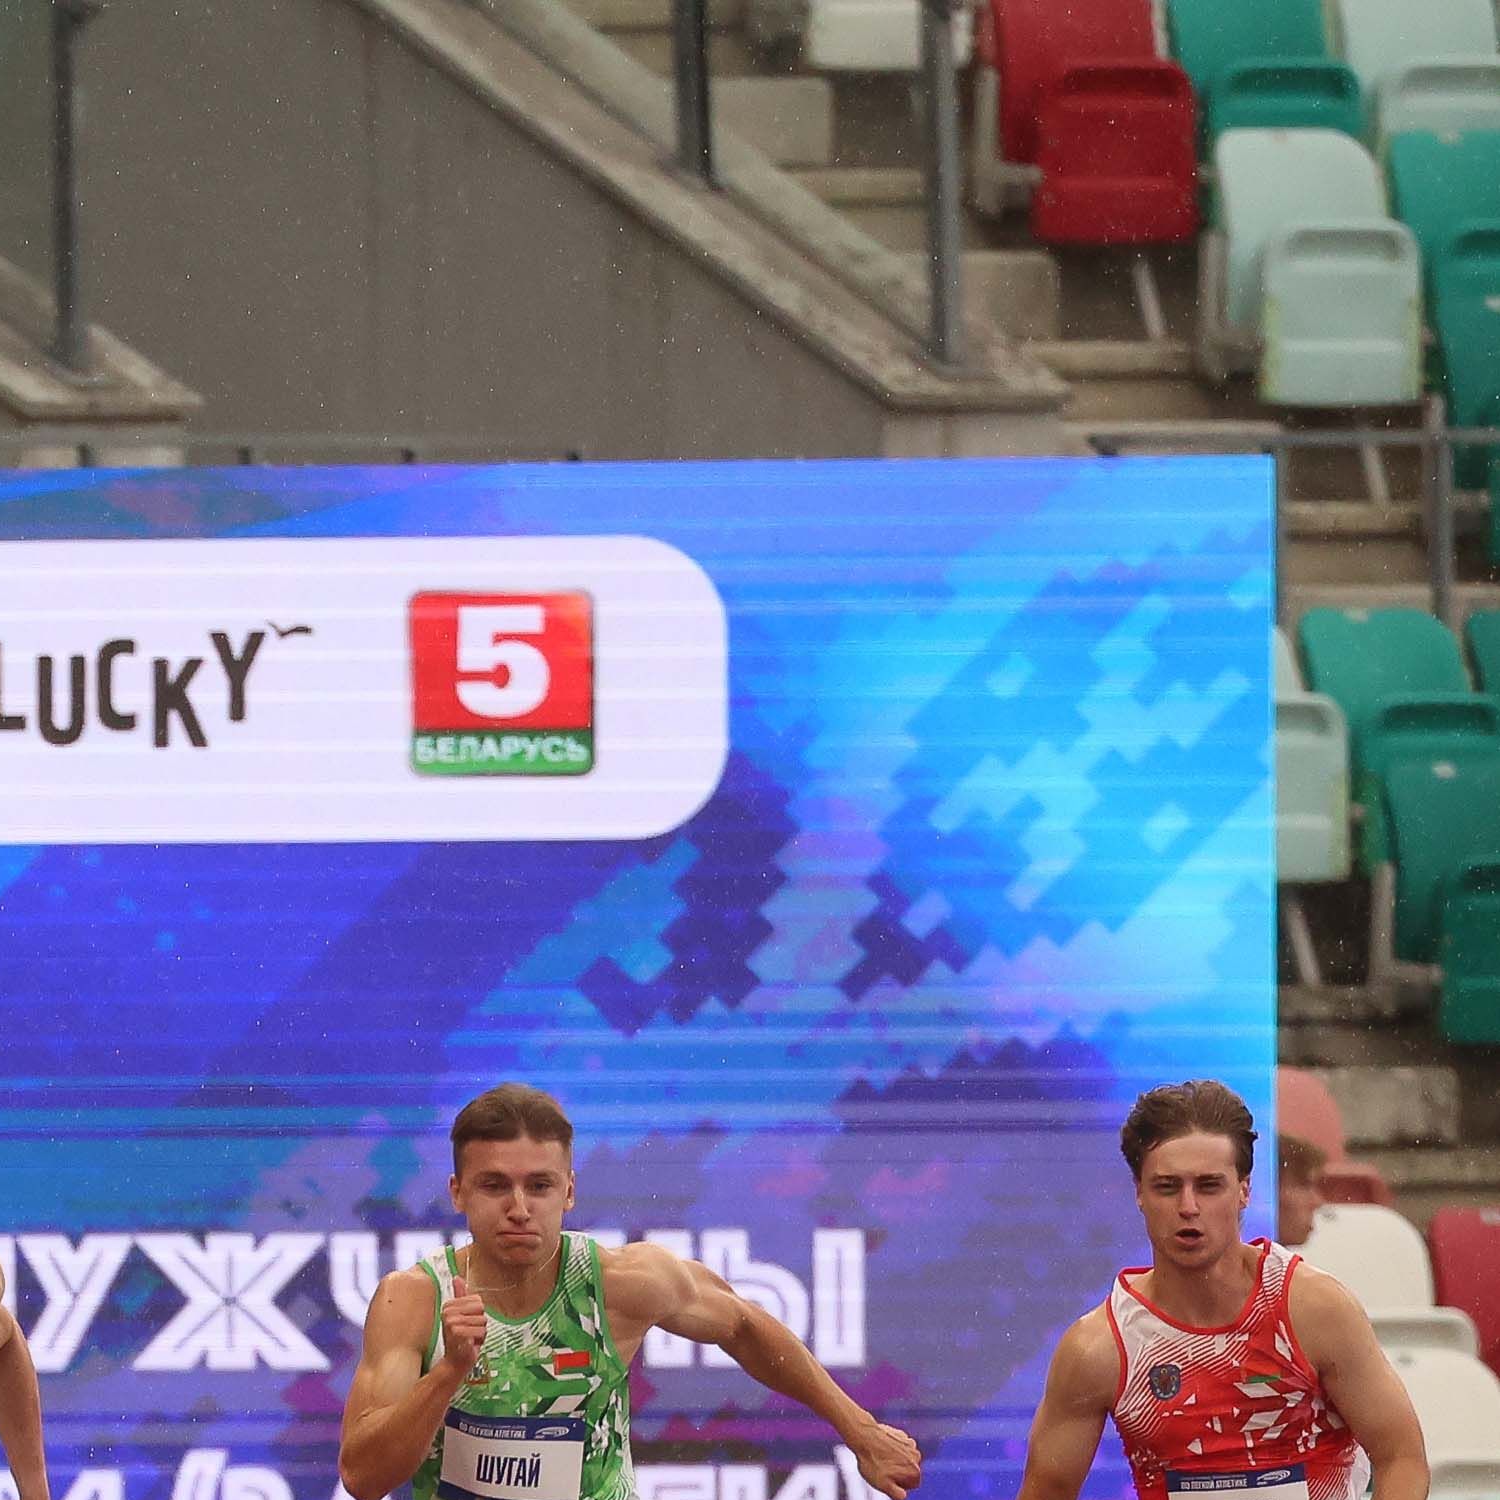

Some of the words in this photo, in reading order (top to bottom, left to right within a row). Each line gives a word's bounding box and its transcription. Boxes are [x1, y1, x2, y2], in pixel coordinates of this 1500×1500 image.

[456, 604, 550, 718] 5
[415, 736, 588, 763] БЕЛАРУСЬ
[476, 1452, 541, 1488] ШУГАЙ
